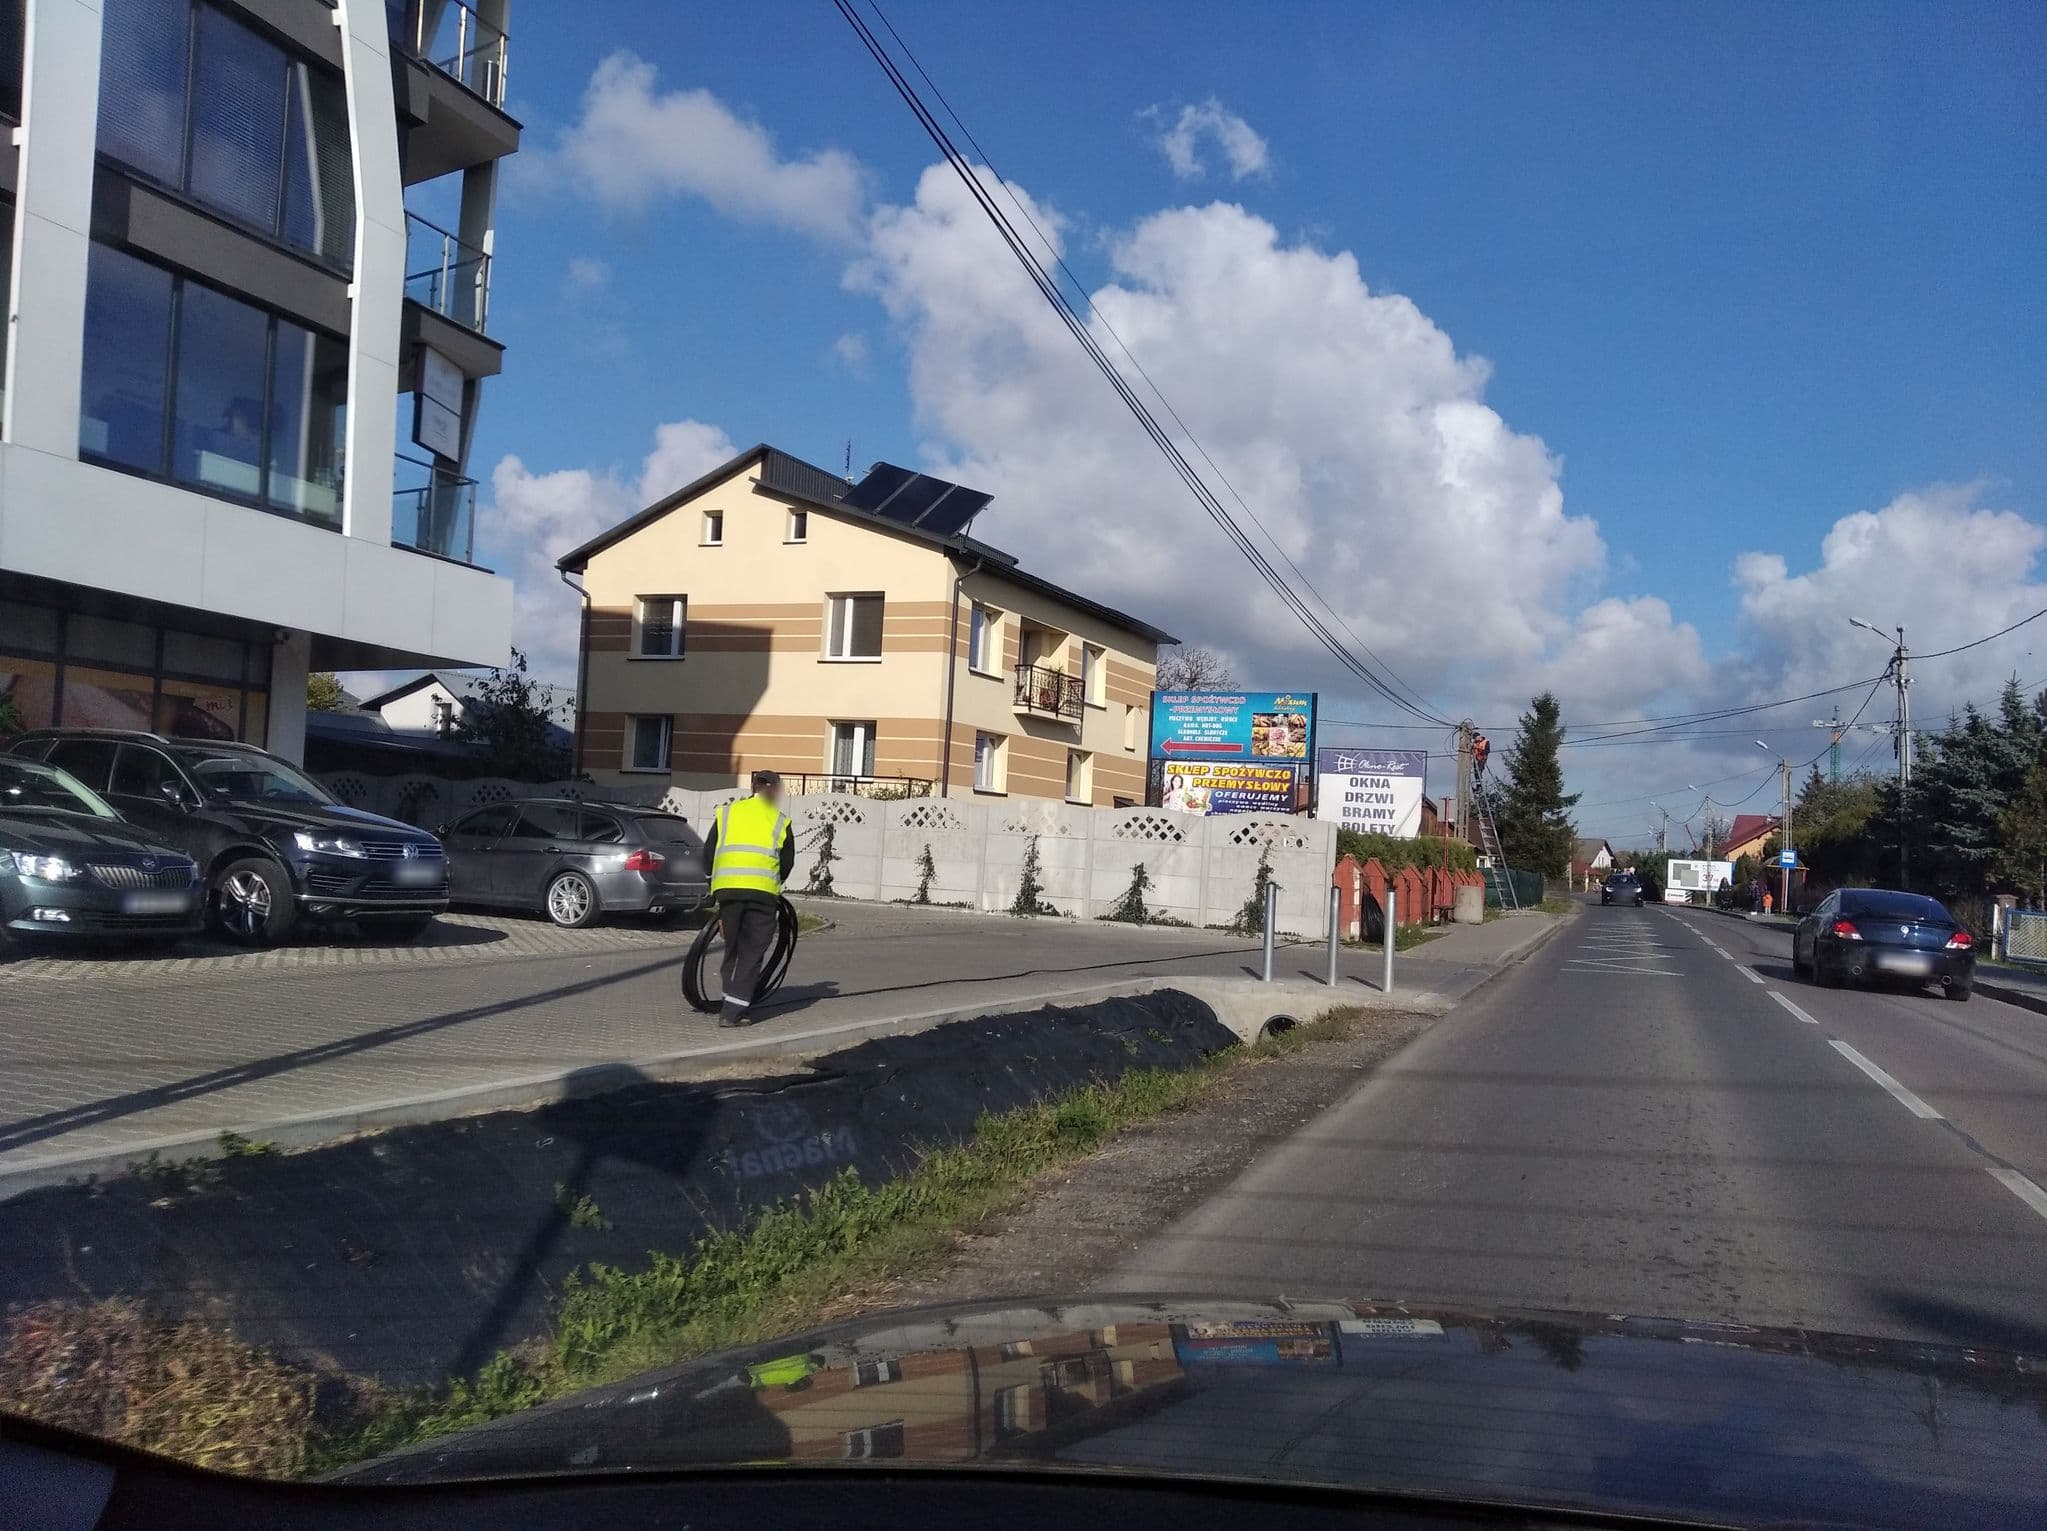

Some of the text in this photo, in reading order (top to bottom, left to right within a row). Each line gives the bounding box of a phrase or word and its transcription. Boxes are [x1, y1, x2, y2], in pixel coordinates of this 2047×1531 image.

[1167, 764, 1291, 779] SKLEP SPOŻYWCZO
[1192, 777, 1290, 792] PRZEMYSŁOWY
[1349, 777, 1391, 789] OKNA
[1214, 791, 1289, 802] OFERUJEMY
[1344, 791, 1394, 804] DRZWI
[1342, 806, 1395, 819] BRAMY
